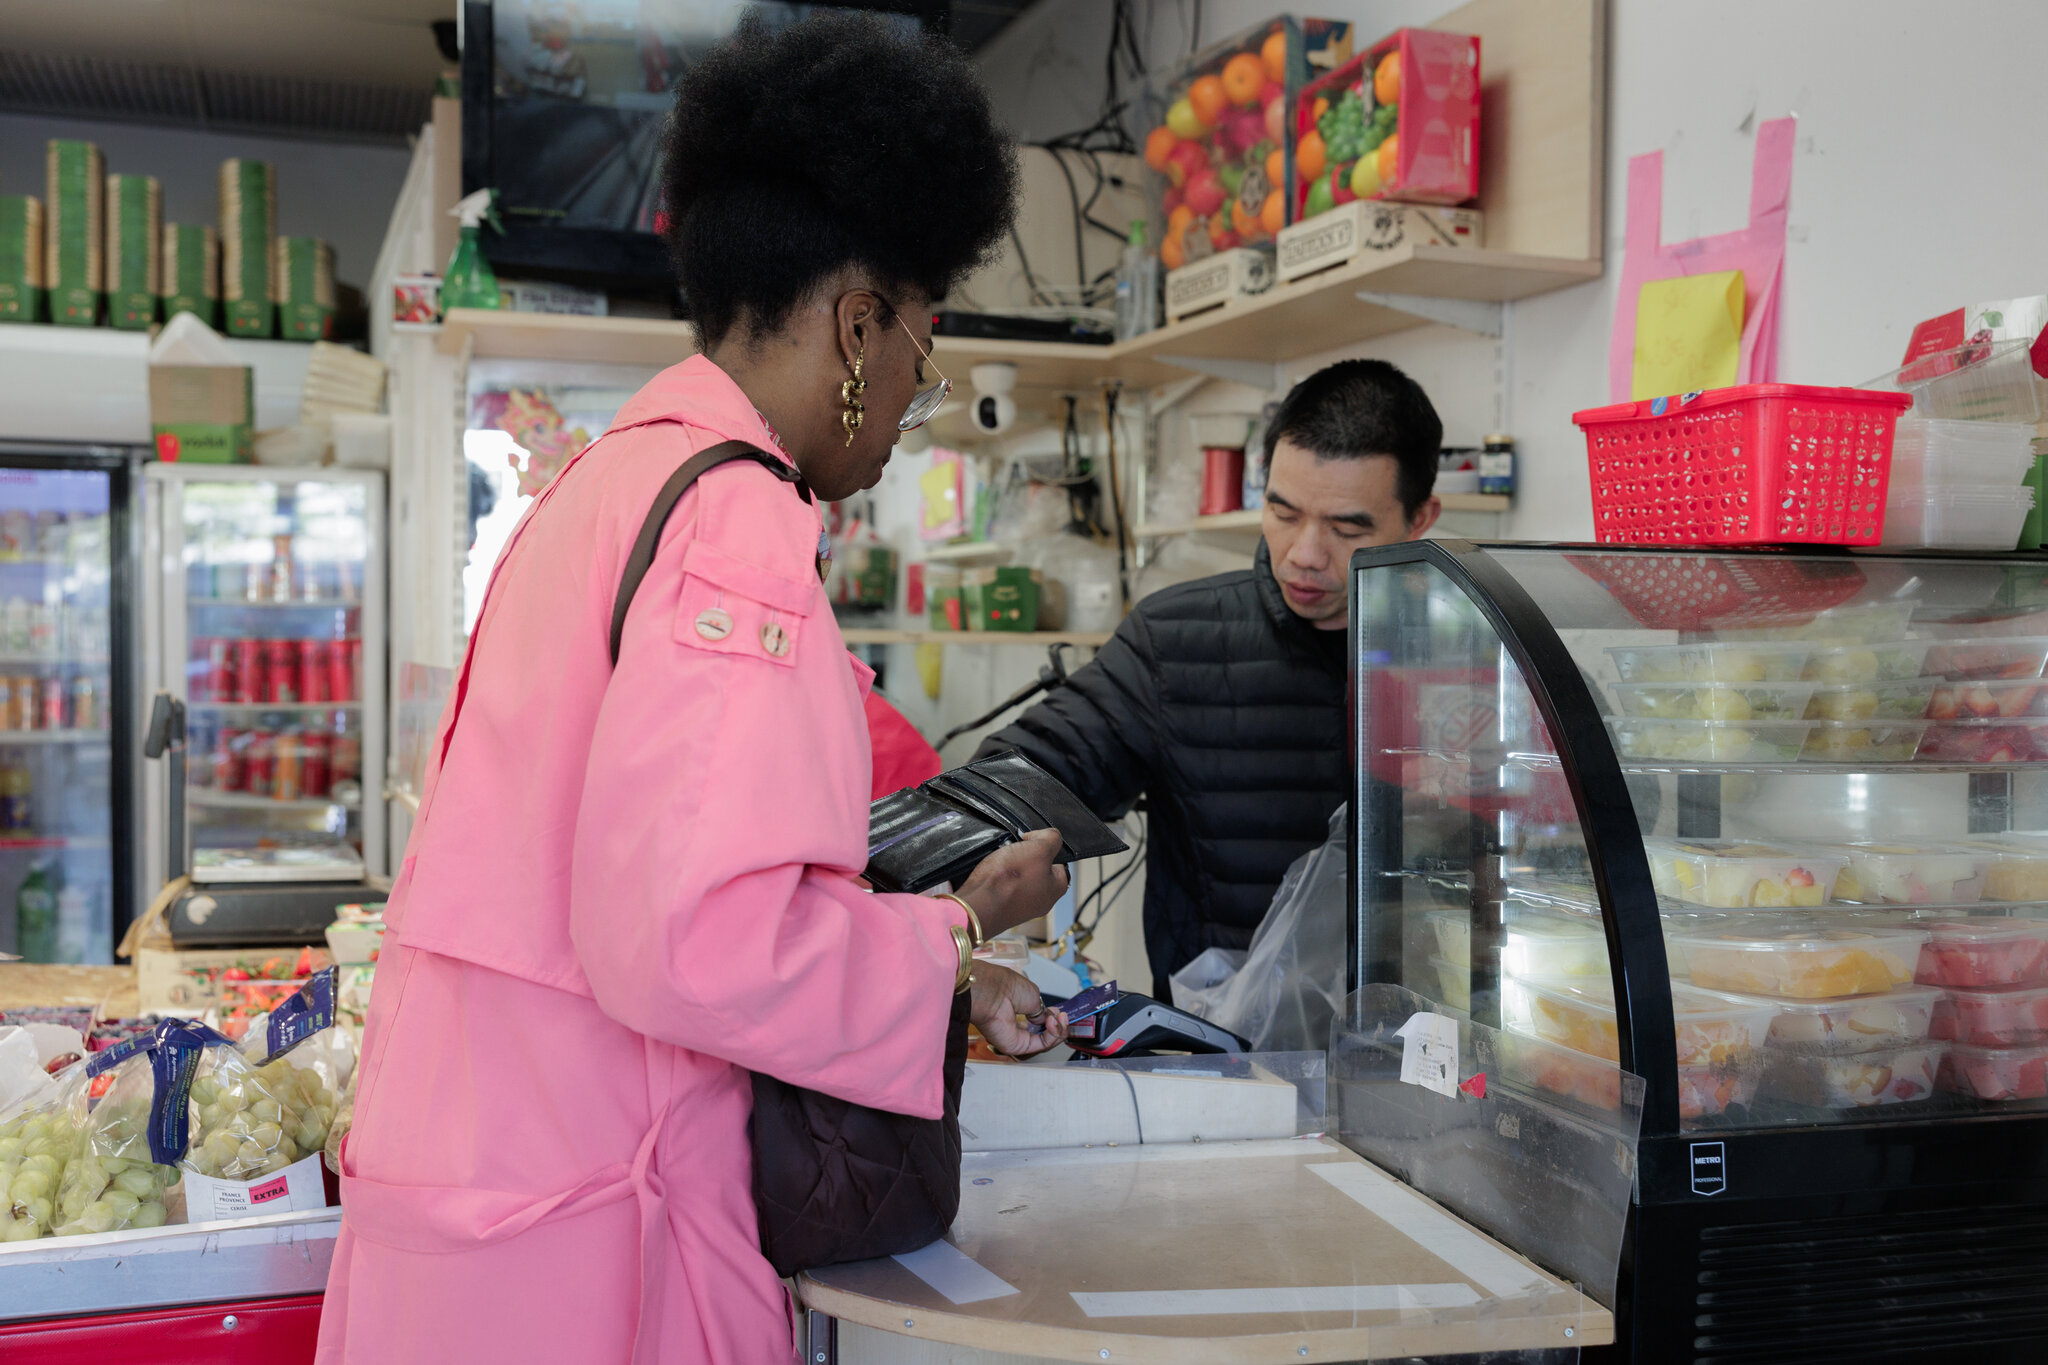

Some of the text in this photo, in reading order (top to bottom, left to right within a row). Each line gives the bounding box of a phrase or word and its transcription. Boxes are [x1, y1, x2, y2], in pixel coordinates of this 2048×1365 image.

[1096, 999, 1115, 1010] VISA
[1695, 1156, 1721, 1164] METRO
[254, 1186, 285, 1201] EXTRA
